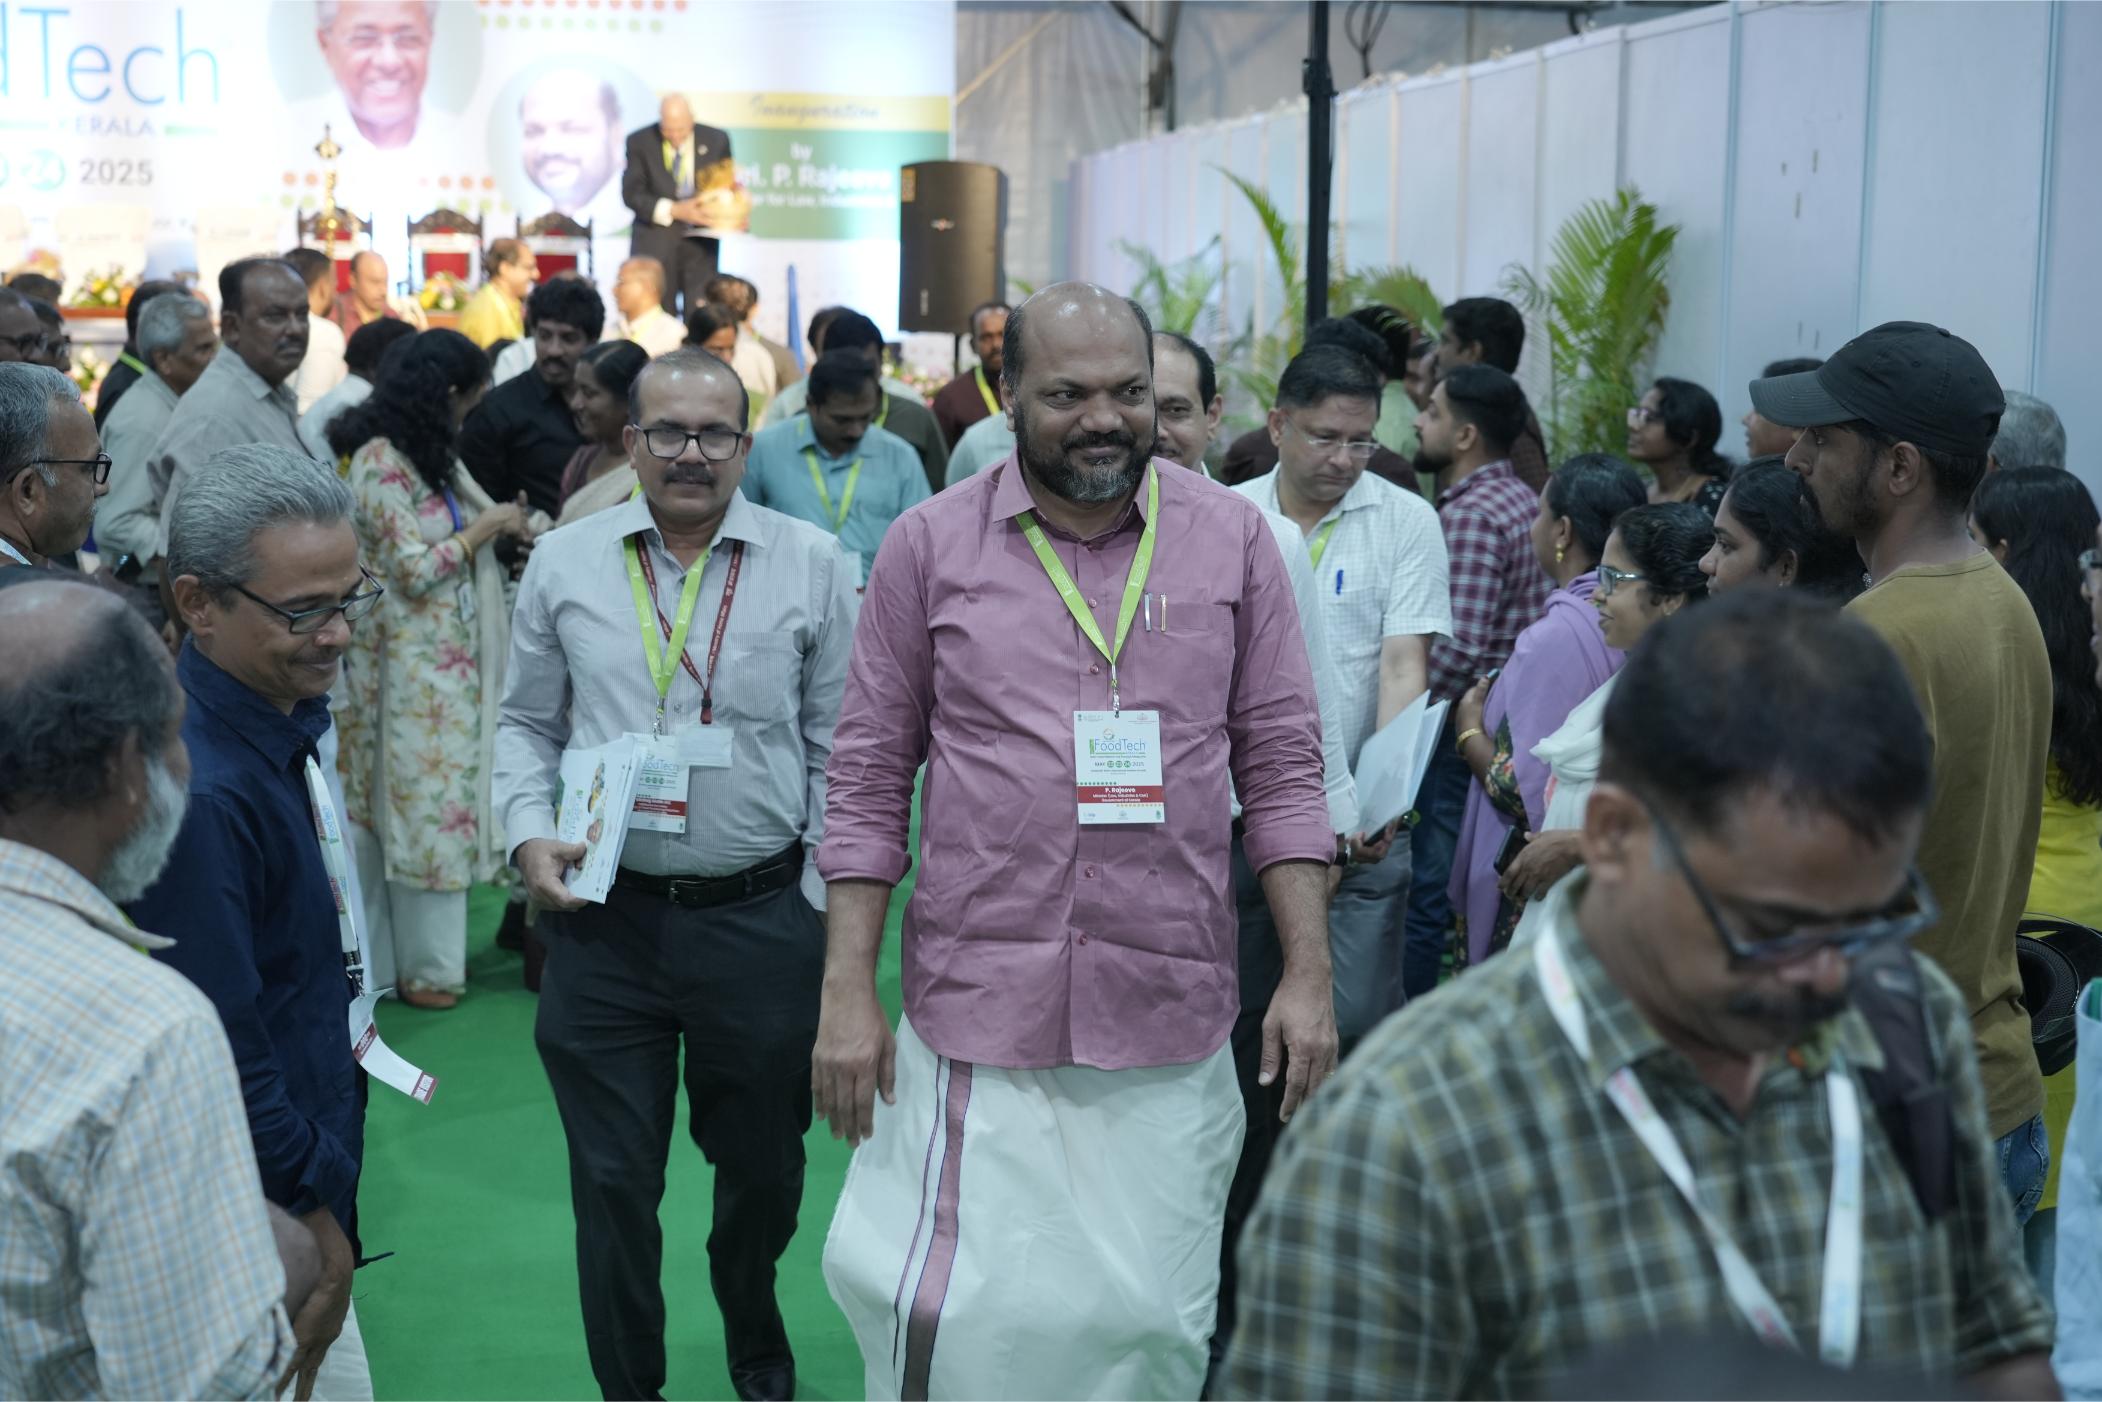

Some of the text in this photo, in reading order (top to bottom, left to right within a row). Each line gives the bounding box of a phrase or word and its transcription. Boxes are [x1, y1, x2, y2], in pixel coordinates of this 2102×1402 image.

[79, 158, 154, 186] 2025
[773, 163, 793, 187] P.
[1094, 738, 1146, 752] FoodTech
